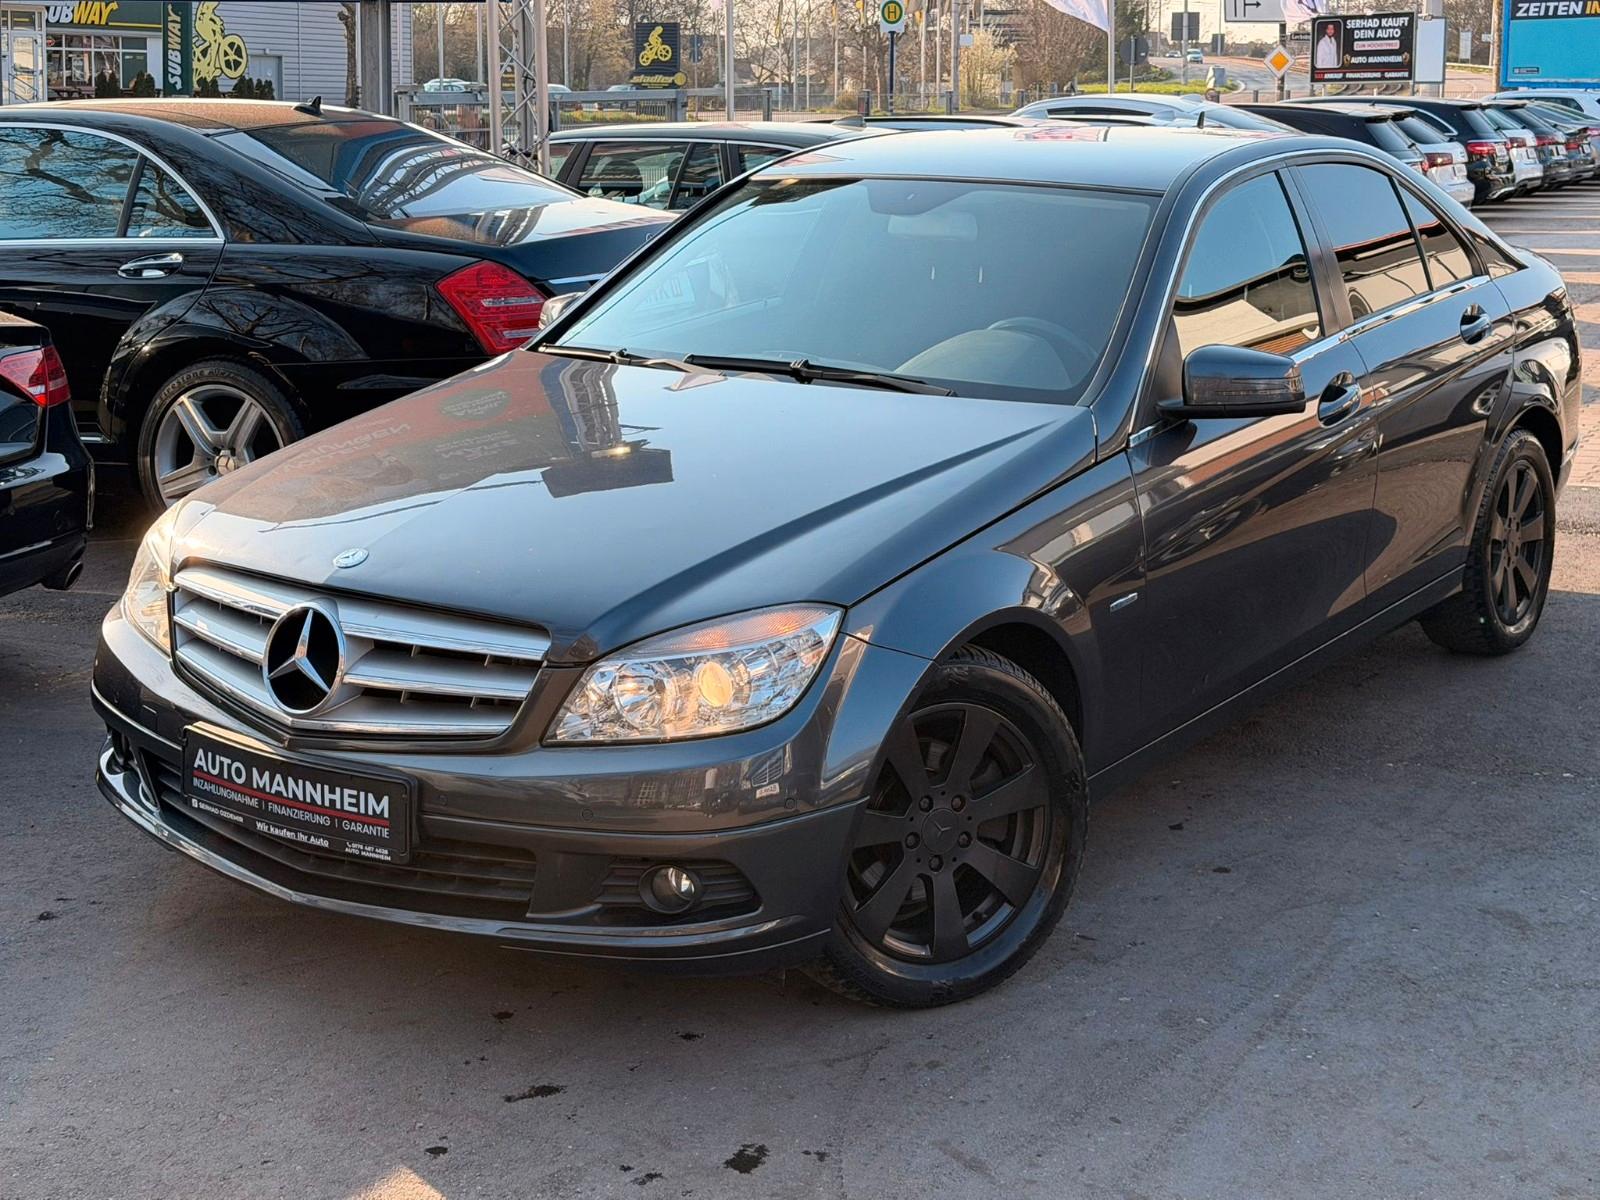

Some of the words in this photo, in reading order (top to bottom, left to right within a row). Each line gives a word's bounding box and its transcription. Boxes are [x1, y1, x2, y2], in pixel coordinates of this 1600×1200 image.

[887, 5, 897, 19] H
[1516, 1, 1583, 17] ZEITEN
[1346, 18, 1379, 29] SERHAD
[1381, 17, 1409, 27] KAUFT
[1354, 29, 1375, 39] DEIN
[1376, 28, 1401, 38] AUTO
[167, 4, 182, 90] SUBWAY
[1351, 56, 1367, 64] AUTO
[1368, 55, 1403, 63] MANNHEIM
[193, 748, 247, 785] AUTO
[252, 767, 390, 818] MANNHEIM
[193, 778, 259, 809] INZAHLUNGNAHME
[268, 803, 330, 826] FINANZIERUNG
[342, 821, 390, 839] GARANTIE
[256, 821, 268, 832] Wir
[270, 825, 296, 839] kaufen
[298, 832, 308, 841] Ihr
[310, 835, 329, 848] Auto
